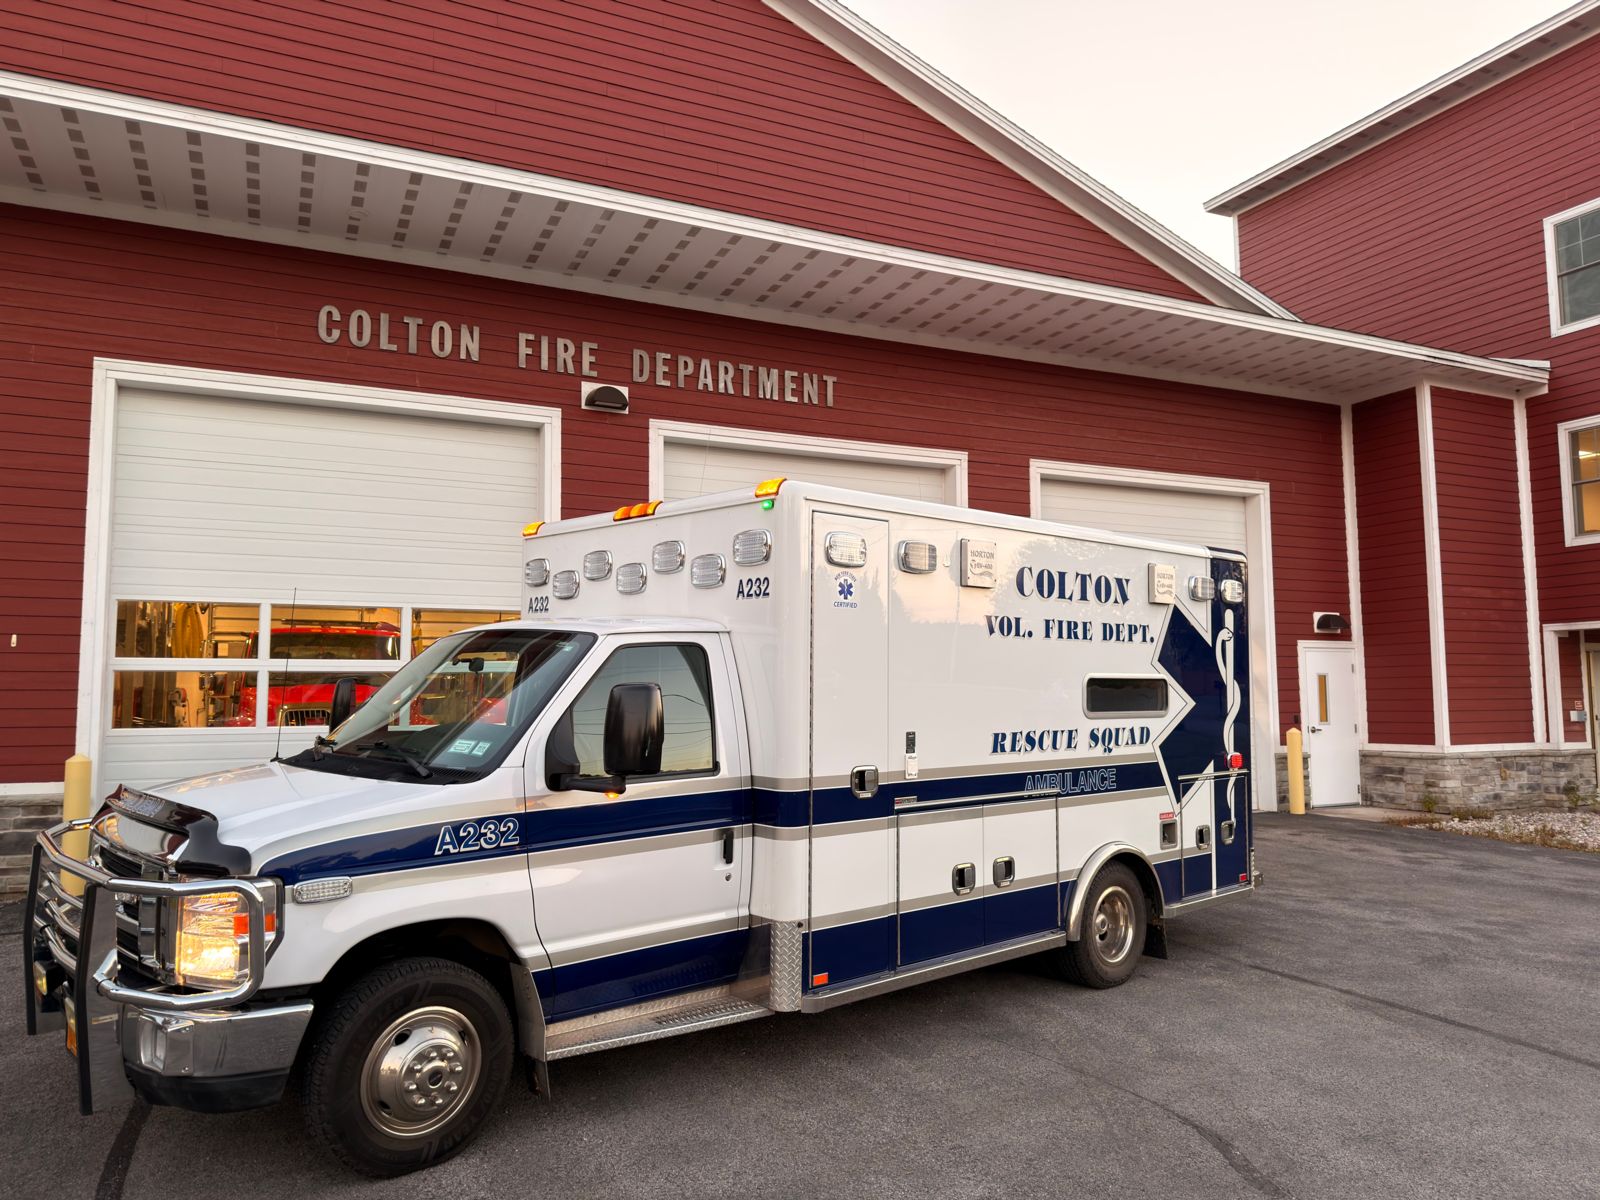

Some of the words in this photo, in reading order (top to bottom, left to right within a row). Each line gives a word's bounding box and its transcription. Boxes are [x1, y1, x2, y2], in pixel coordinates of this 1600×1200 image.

[317, 304, 481, 363] COLTON
[517, 332, 599, 378] FIRE
[631, 348, 838, 407] DEPARTMENT
[736, 577, 770, 600] A232
[1015, 565, 1131, 606] COLTON
[528, 595, 550, 614] A232
[985, 614, 1034, 639] VOL.
[1043, 618, 1094, 642] FIRE
[1101, 621, 1155, 645] DEPT.
[990, 728, 1079, 756] RESCUE
[1089, 725, 1151, 754] SQUAD
[1024, 768, 1117, 795] AMBULANCE
[434, 817, 520, 855] A232
